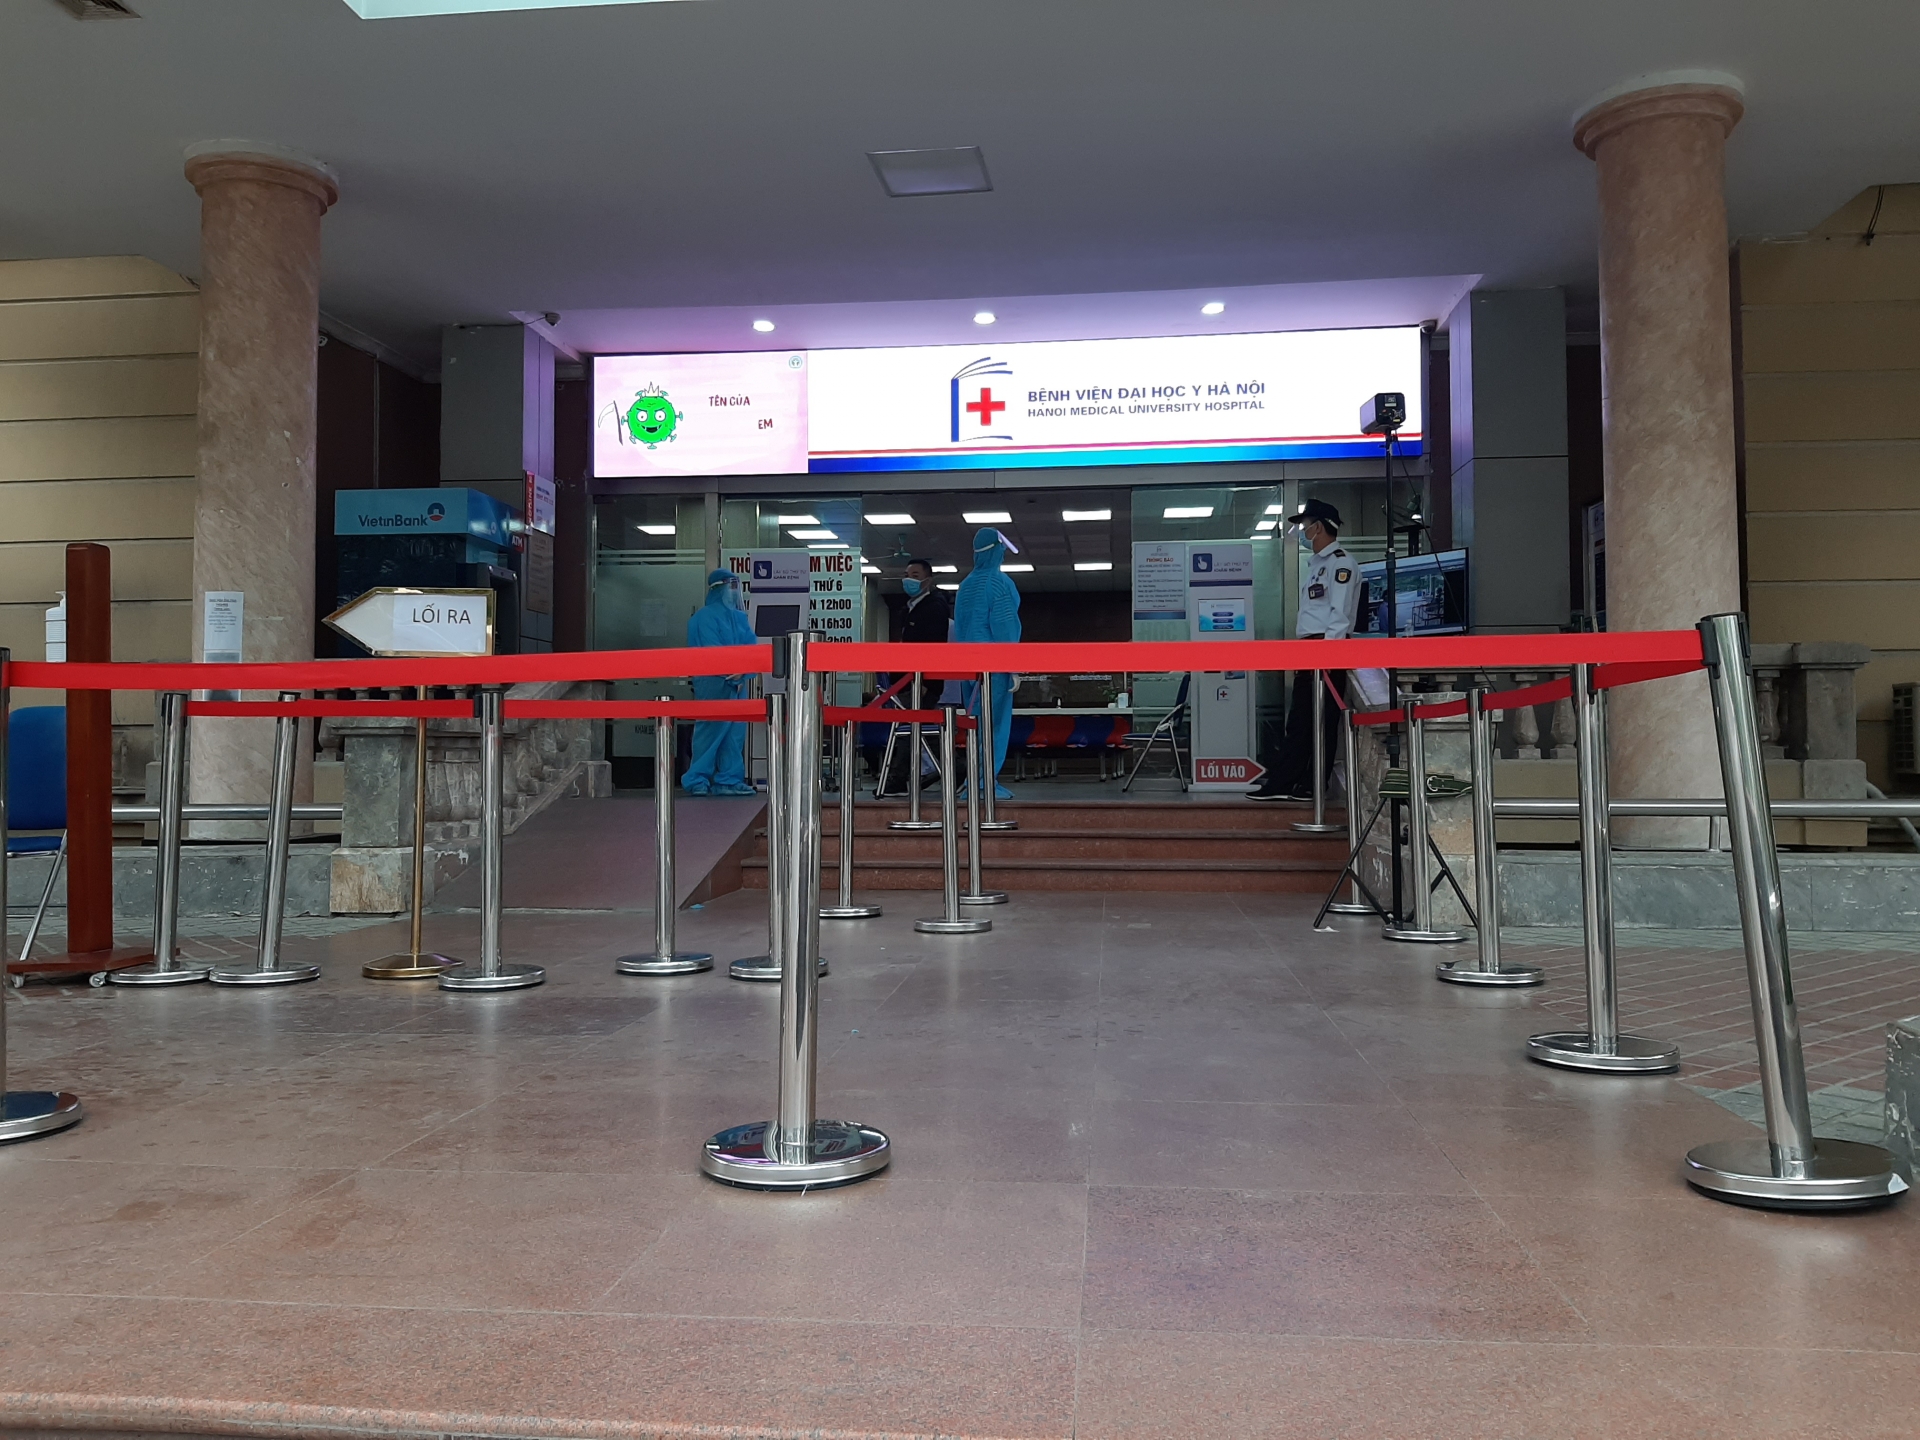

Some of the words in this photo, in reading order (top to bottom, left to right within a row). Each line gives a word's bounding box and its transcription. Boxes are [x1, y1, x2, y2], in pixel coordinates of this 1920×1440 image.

[1027, 387, 1070, 405] BỆNH
[1075, 386, 1112, 404] VIỆN
[1118, 386, 1147, 402] ĐẠI
[1151, 385, 1186, 401] HỌC
[1192, 385, 1202, 396] Y
[1207, 381, 1231, 396] HÀ
[1236, 379, 1265, 398] NỘI
[709, 394, 727, 407] TÊN
[1027, 407, 1066, 417] HANOI
[1070, 405, 1125, 416] MEDICAL
[1128, 403, 1201, 414] UNIVERSITY
[1204, 401, 1265, 411] HOSPITAL
[758, 418, 773, 430] EM
[358, 514, 428, 527] VietinBank
[511, 534, 523, 548] ATM
[730, 553, 750, 574] TH
[825, 552, 853, 577] VIỆC
[813, 577, 834, 592] THỨ
[836, 581, 843, 592] 6
[820, 598, 851, 610] 12h00
[413, 603, 440, 624] LỐI
[447, 608, 471, 625] RA
[820, 618, 852, 629] 16h30
[1200, 760, 1219, 778] LỐI
[1222, 762, 1246, 778] VÀO
